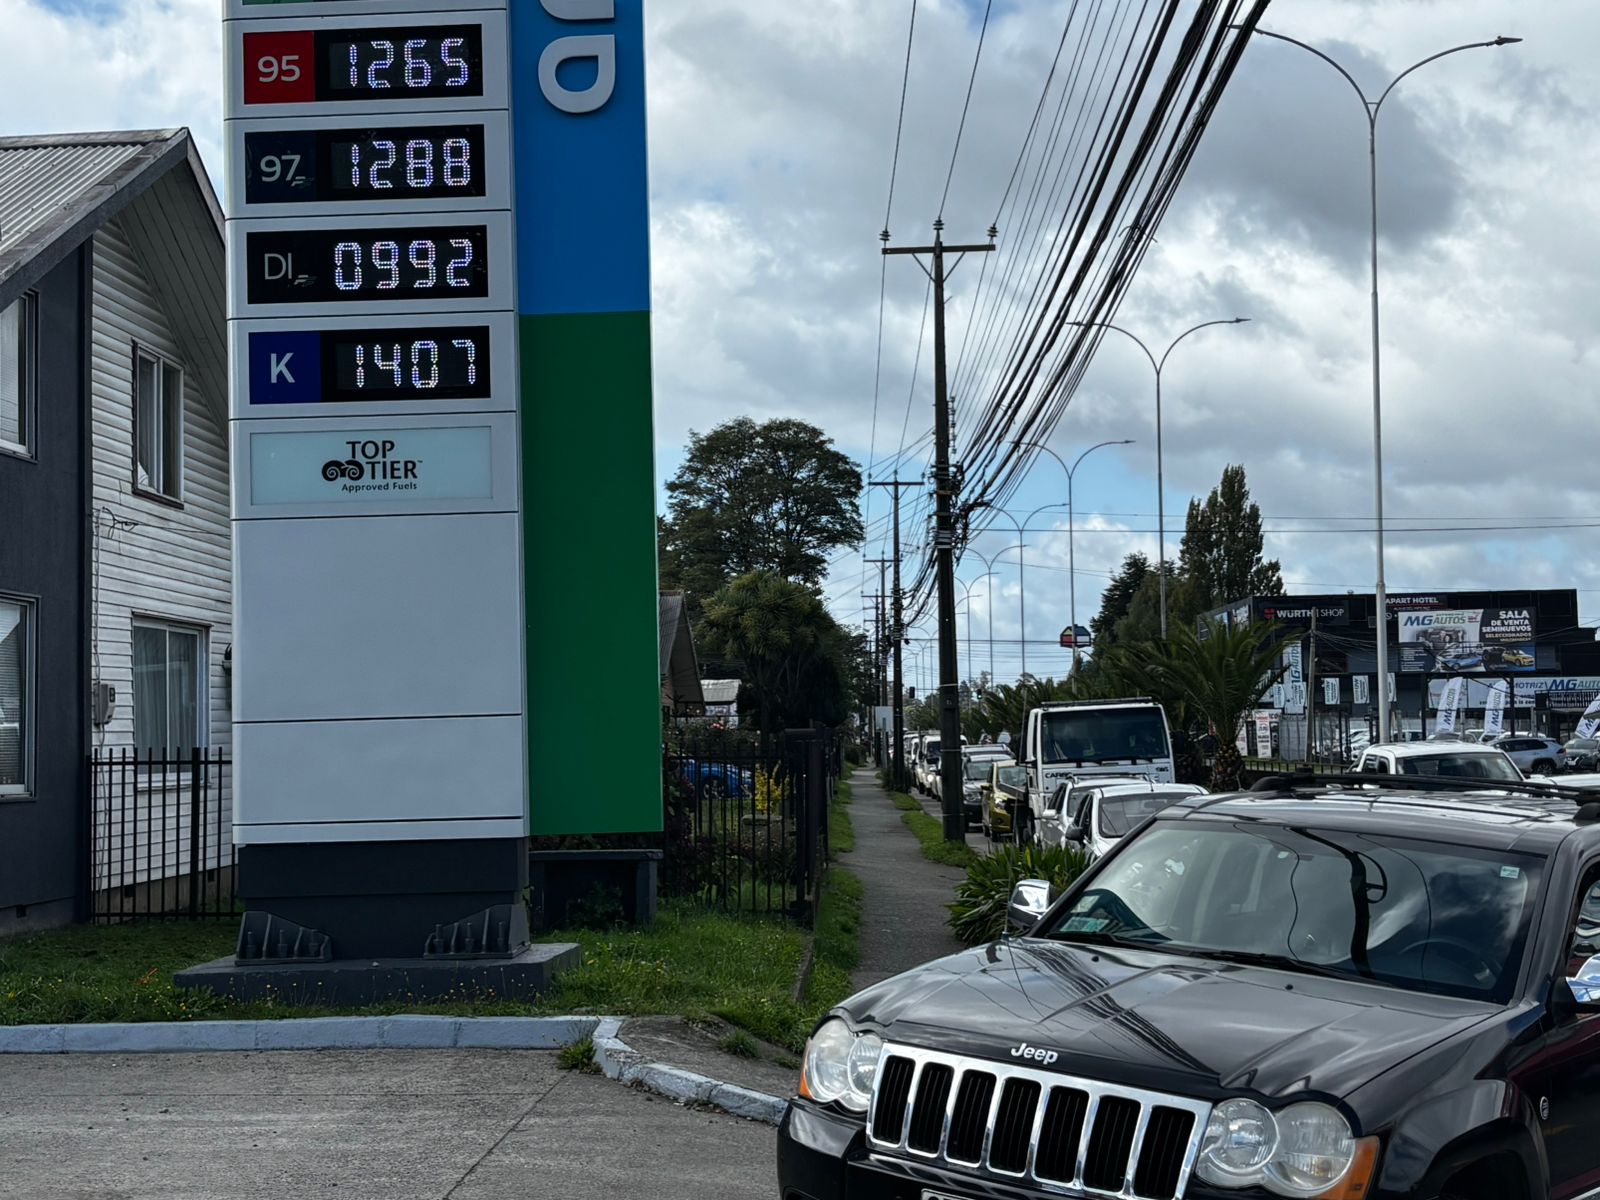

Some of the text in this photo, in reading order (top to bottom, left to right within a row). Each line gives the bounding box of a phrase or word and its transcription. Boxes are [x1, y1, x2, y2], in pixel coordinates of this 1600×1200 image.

[257, 38, 469, 89] 95 1265
[259, 138, 471, 189] 97 1288
[334, 238, 473, 291] 0992
[270, 339, 476, 389] K 1407
[346, 440, 395, 459] TOP
[365, 460, 417, 480] TIER
[341, 482, 417, 493] Approved Fuels
[1320, 608, 1345, 617] SHOP
[1403, 615, 1433, 626] MG
[1499, 610, 1530, 619] SALA
[1550, 679, 1577, 690] MG
[1010, 1042, 1059, 1065] Jeep
